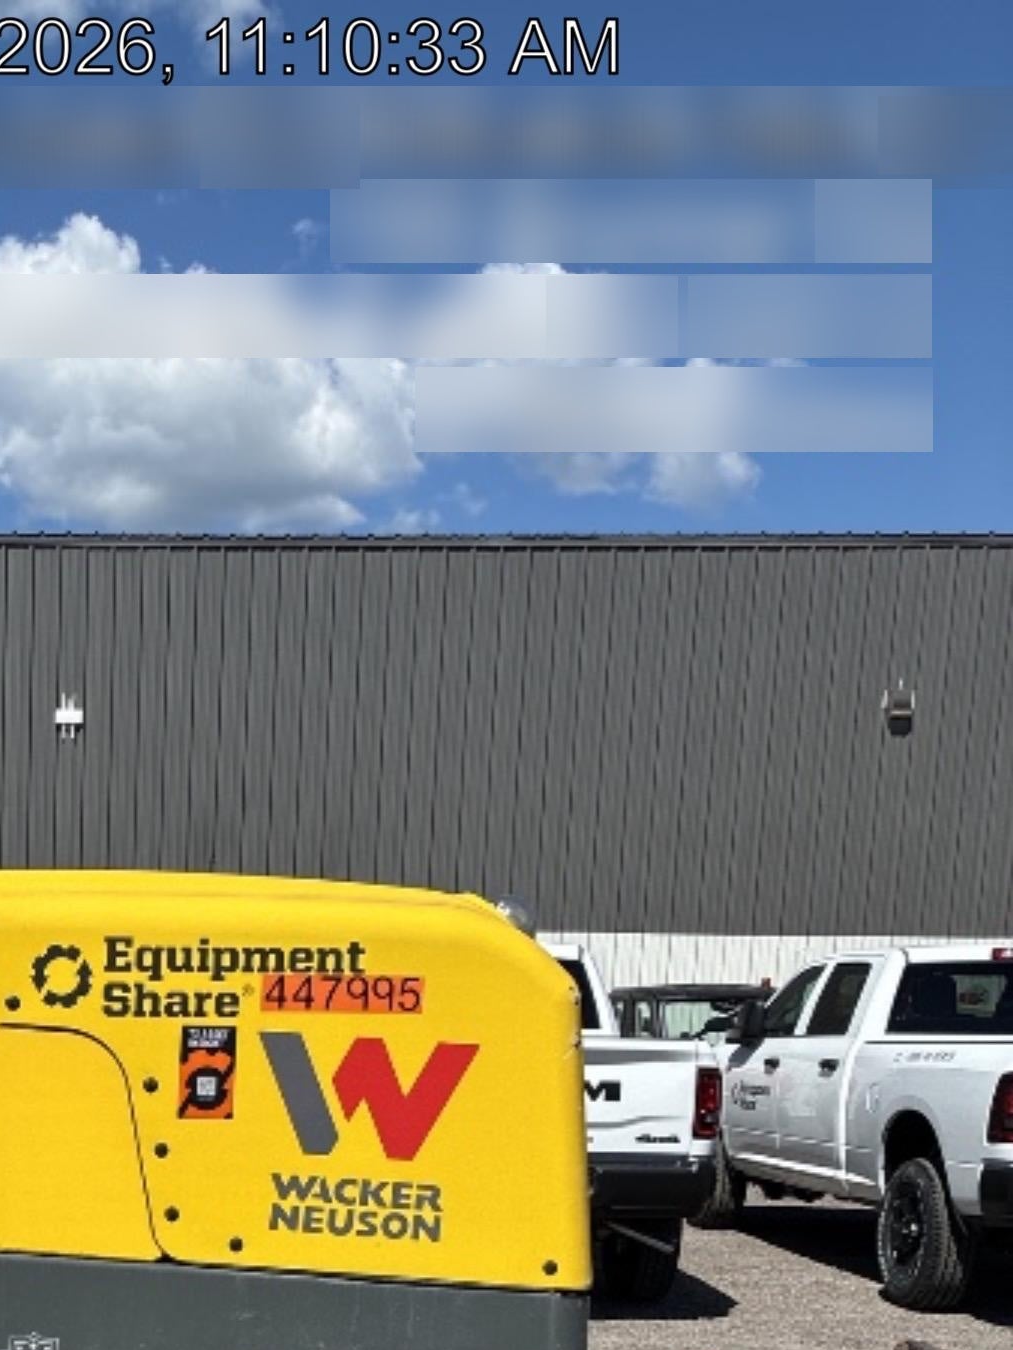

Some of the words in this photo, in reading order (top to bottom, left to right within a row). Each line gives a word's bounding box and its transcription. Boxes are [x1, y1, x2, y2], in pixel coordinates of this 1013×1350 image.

[103, 936, 366, 981] Equipment
[265, 975, 421, 1012] 447995
[271, 1173, 442, 1212] WACKER
[268, 1203, 441, 1243] NEUSON
